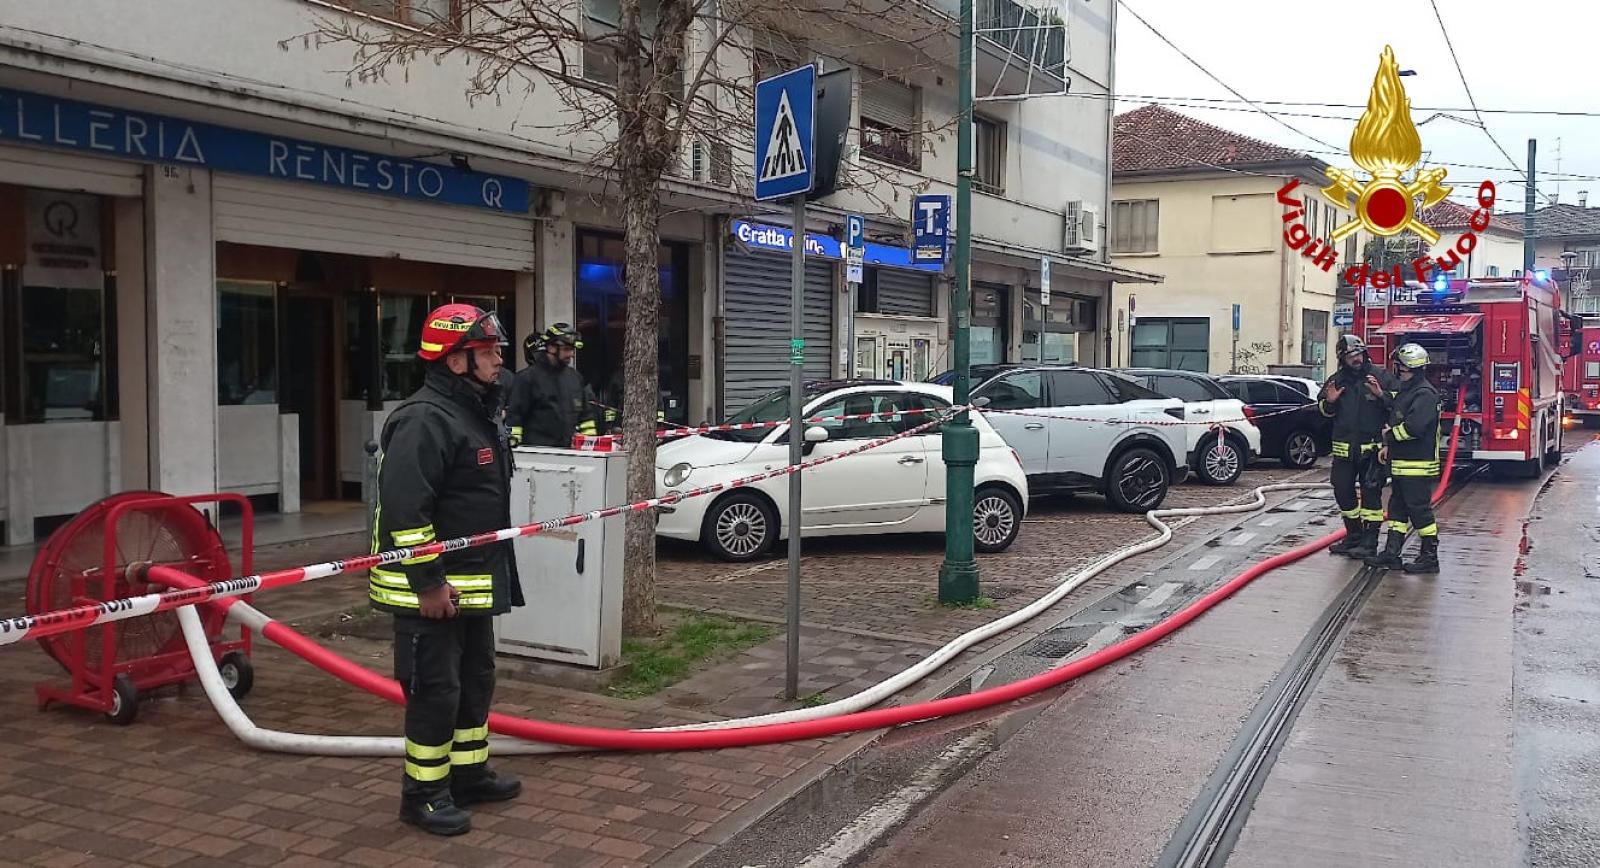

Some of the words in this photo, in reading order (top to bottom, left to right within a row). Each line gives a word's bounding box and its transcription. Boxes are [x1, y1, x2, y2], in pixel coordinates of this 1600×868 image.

[0, 96, 206, 164] LLERIA
[269, 140, 444, 197] RENESTO
[850, 217, 861, 246] P
[919, 202, 942, 234] T
[738, 223, 785, 247] Gratta
